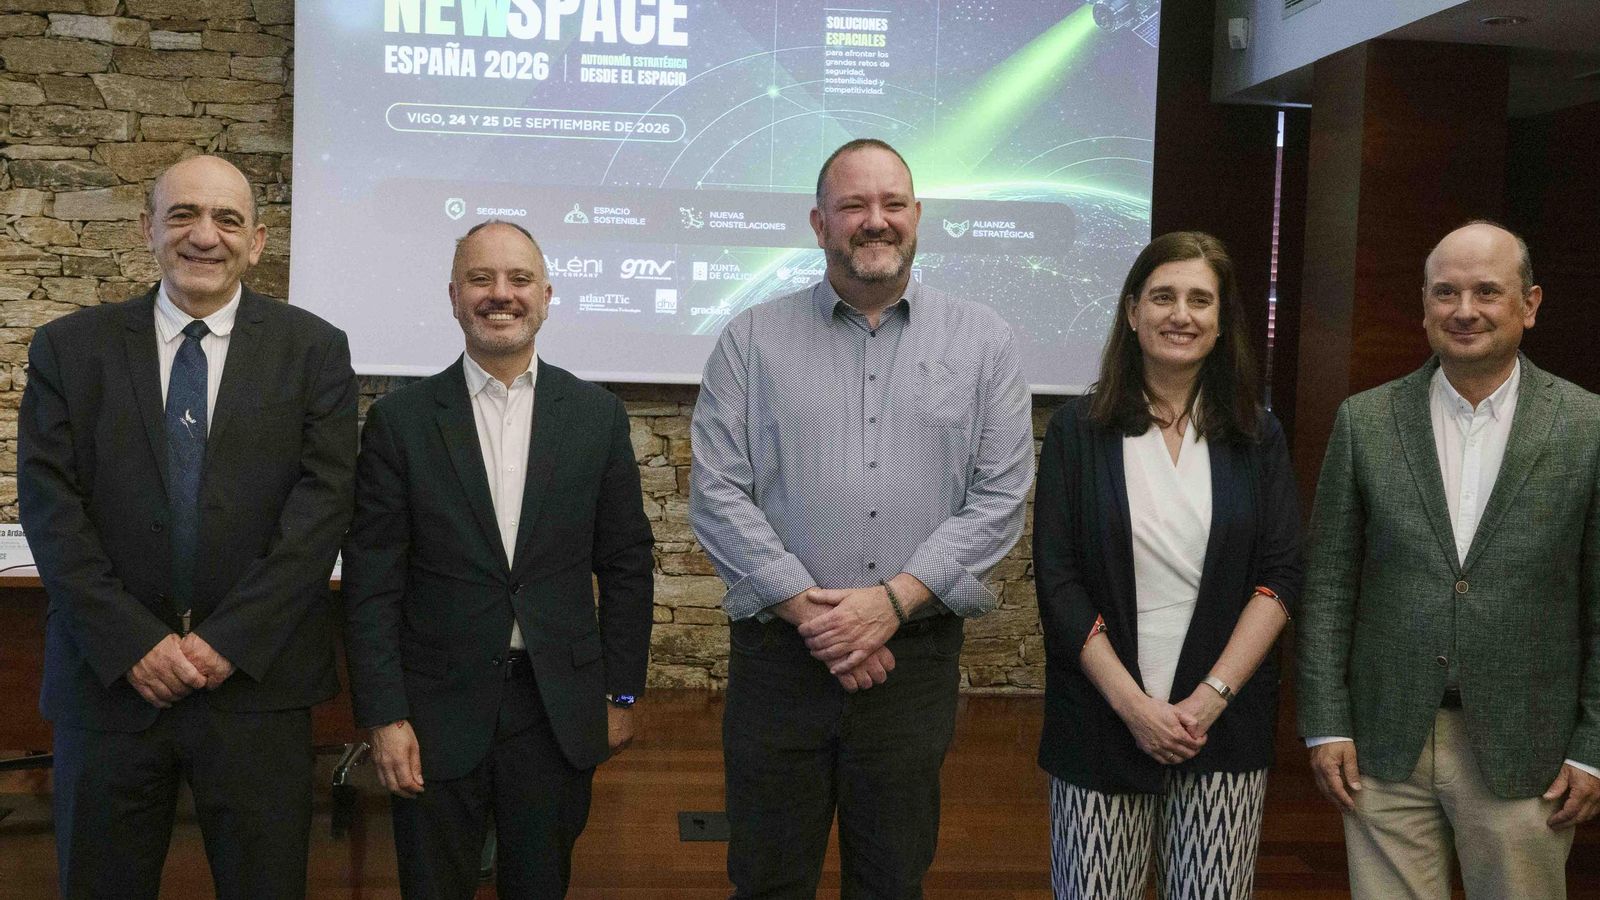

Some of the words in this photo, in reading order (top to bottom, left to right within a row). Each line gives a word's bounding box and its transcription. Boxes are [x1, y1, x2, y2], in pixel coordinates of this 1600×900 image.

[826, 16, 889, 31] SOLUCIONES
[826, 32, 887, 47] ESPACIALES
[845, 50, 876, 58] afrontar
[384, 42, 477, 77] ESPAÑA
[484, 50, 549, 80] 2026
[581, 53, 631, 67] AUTONOMÍA
[633, 55, 688, 69] ESTRATÉGICA
[825, 59, 857, 67] grandes
[880, 60, 890, 68] de
[580, 67, 618, 83] DESDE
[621, 69, 635, 84] EL
[637, 70, 687, 86] ESPACIO
[407, 112, 446, 126] VIGO,
[448, 114, 466, 126] 24
[469, 115, 480, 126] Y
[482, 116, 500, 127] 25
[503, 117, 522, 128] DE
[525, 117, 611, 132] SEPTIEMBRE
[614, 121, 635, 132] DE
[637, 123, 670, 134] 2026
[476, 207, 527, 217] SEGURIDAD
[593, 207, 631, 216] ESPACIO
[709, 211, 745, 220] NUEVAS
[593, 216, 646, 226] SOSTENIBLE
[709, 220, 787, 231] CONSTELACIONES
[972, 220, 1016, 229] ALIANZAS
[972, 229, 1035, 239] ESTRATÉGICAS
[709, 263, 741, 273] XUNTA
